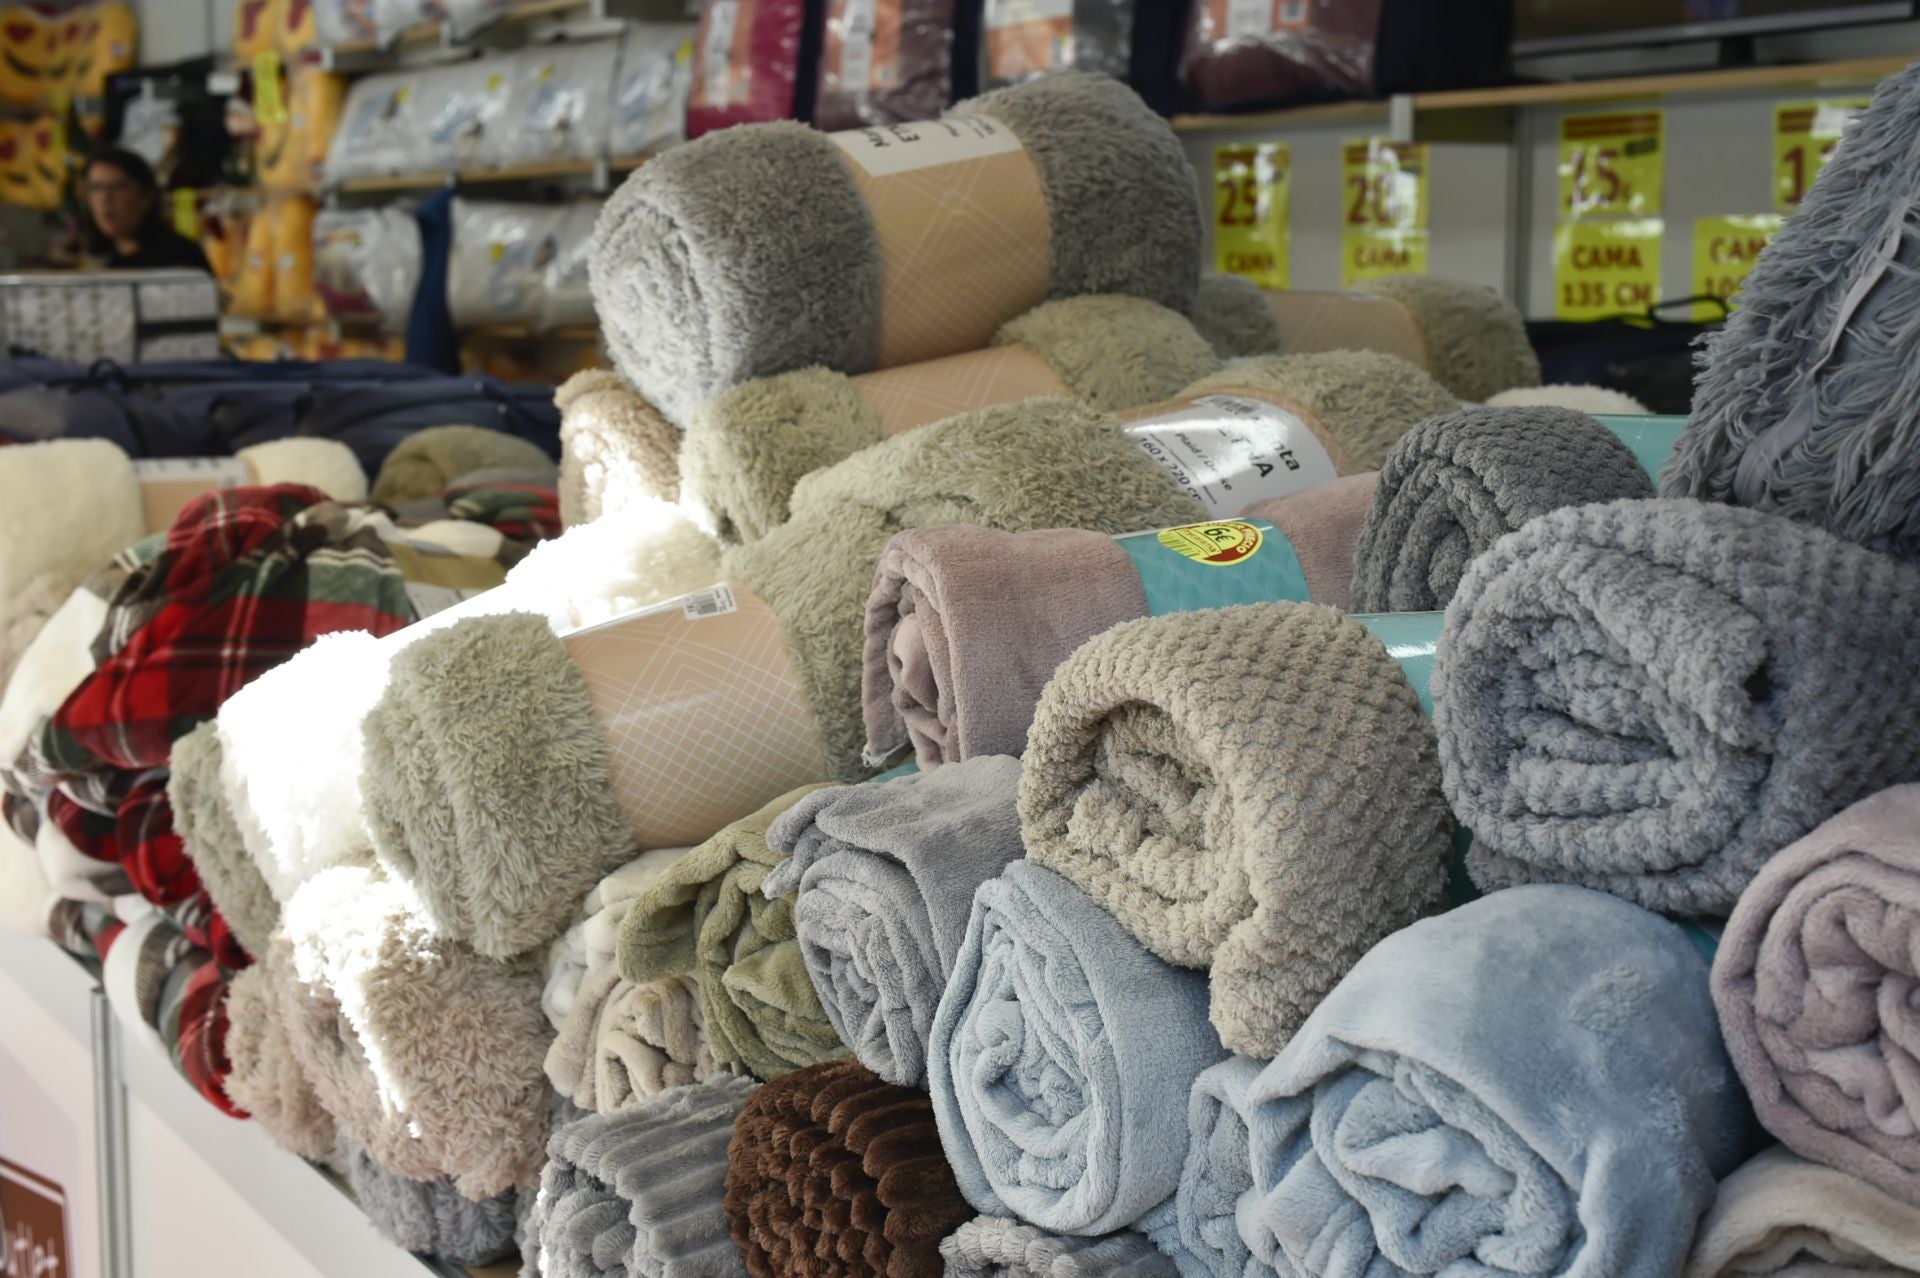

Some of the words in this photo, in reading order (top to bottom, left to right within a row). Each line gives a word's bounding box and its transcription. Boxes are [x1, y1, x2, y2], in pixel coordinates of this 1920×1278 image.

[1225, 252, 1277, 272] CAMA
[1353, 246, 1411, 269] CAMA
[1570, 245, 1643, 271] CAMA
[1708, 237, 1764, 264] CAM
[1561, 282, 1608, 307] 135
[1612, 281, 1652, 307] CM
[1169, 464, 1192, 486] 220
[1203, 527, 1236, 543] 6€
